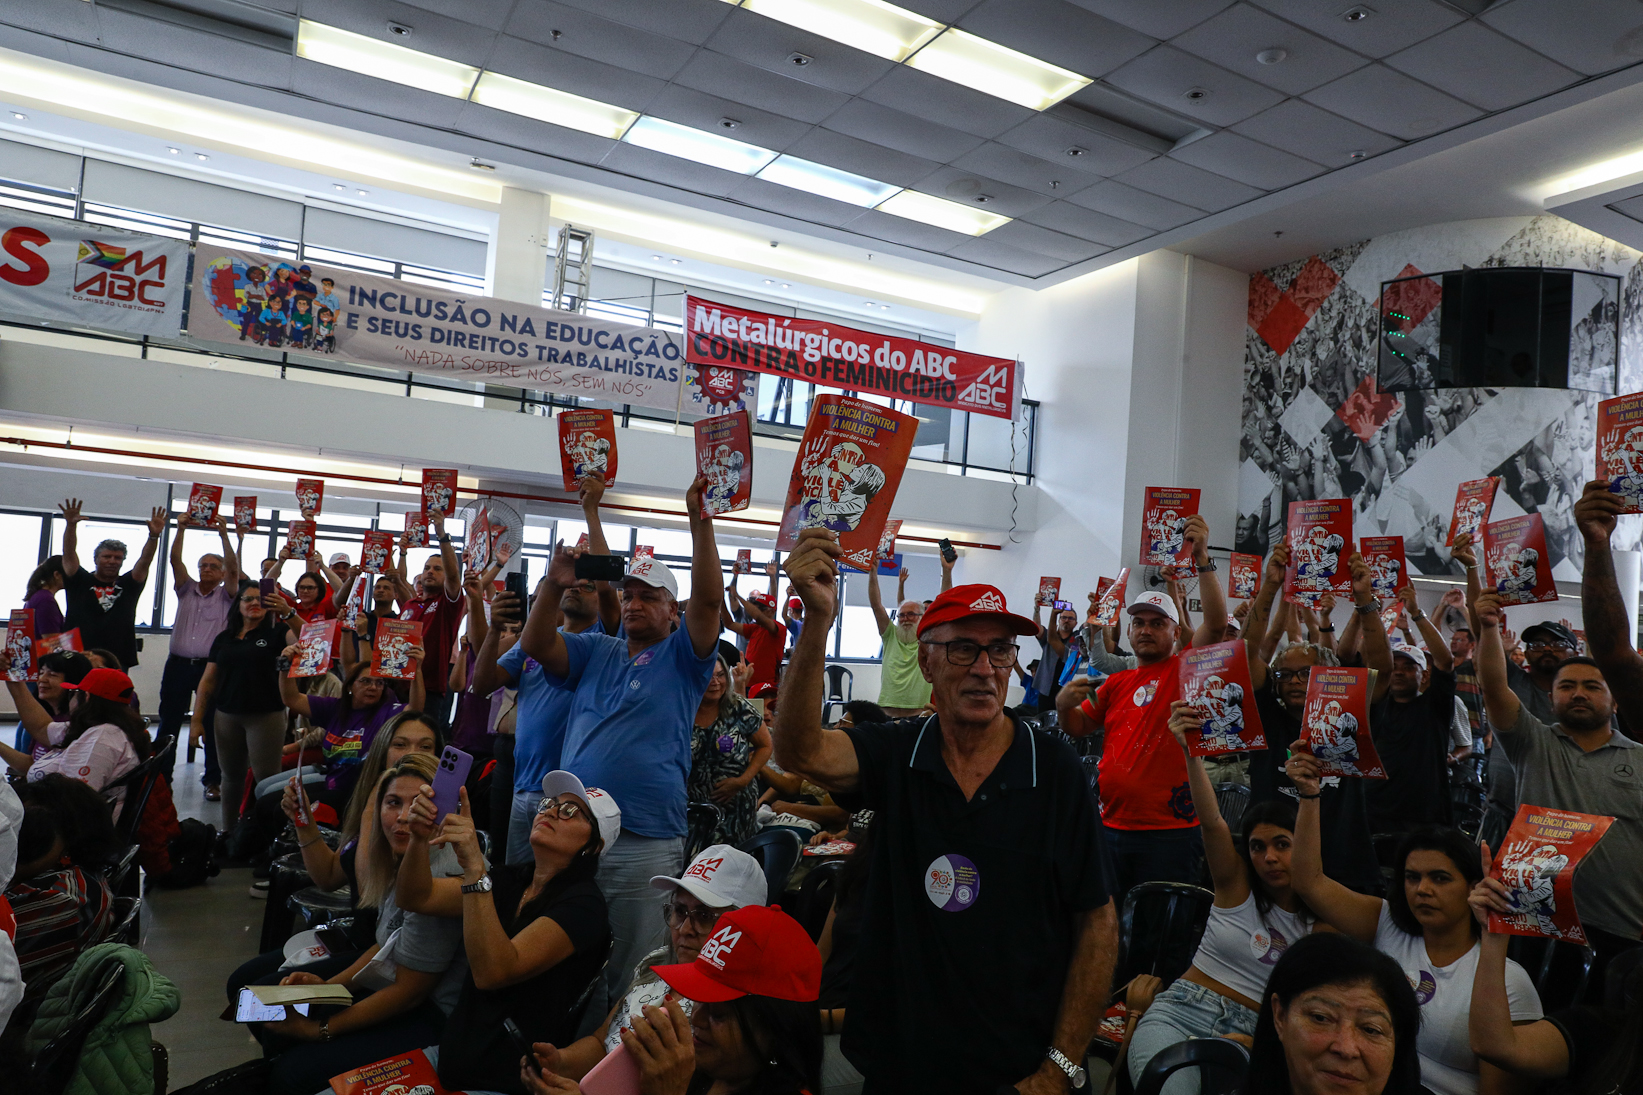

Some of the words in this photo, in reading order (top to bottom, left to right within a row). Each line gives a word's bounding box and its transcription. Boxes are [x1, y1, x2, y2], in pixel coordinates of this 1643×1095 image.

[0, 226, 51, 286] S
[74, 272, 166, 308] ABC
[348, 285, 492, 329] INCLUSÃO
[500, 314, 536, 338] NA
[546, 321, 680, 362] EDUCAÇÃO
[346, 312, 358, 330] E
[366, 316, 422, 341] SEUS
[430, 326, 528, 358] DIREITOS
[536, 344, 679, 383] TRABALHISTAS
[694, 305, 870, 362] Metalúrgicos
[874, 341, 906, 372] do
[910, 349, 957, 380] ABC
[462, 356, 521, 378] SOBRE
[572, 374, 606, 390] SEM
[694, 333, 800, 376] CONTRA
[820, 357, 957, 402] FEMINICÍDIO
[958, 382, 1006, 408] ABC
[1608, 401, 1639, 414] VIOLÊNCIA
[822, 404, 861, 420] VIOLÊNCIA
[862, 414, 896, 432] CONTRA
[832, 419, 839, 428] A
[840, 420, 876, 438] MULHER
[849, 434, 860, 442] dar
[848, 553, 871, 566] ABC
[1529, 815, 1562, 827] VIOLÊNCIA
[1563, 822, 1592, 831] CONTRA
[1544, 830, 1573, 840] MULHER
[373, 1070, 401, 1083] MULHER
[383, 1059, 411, 1072] CONTRA
